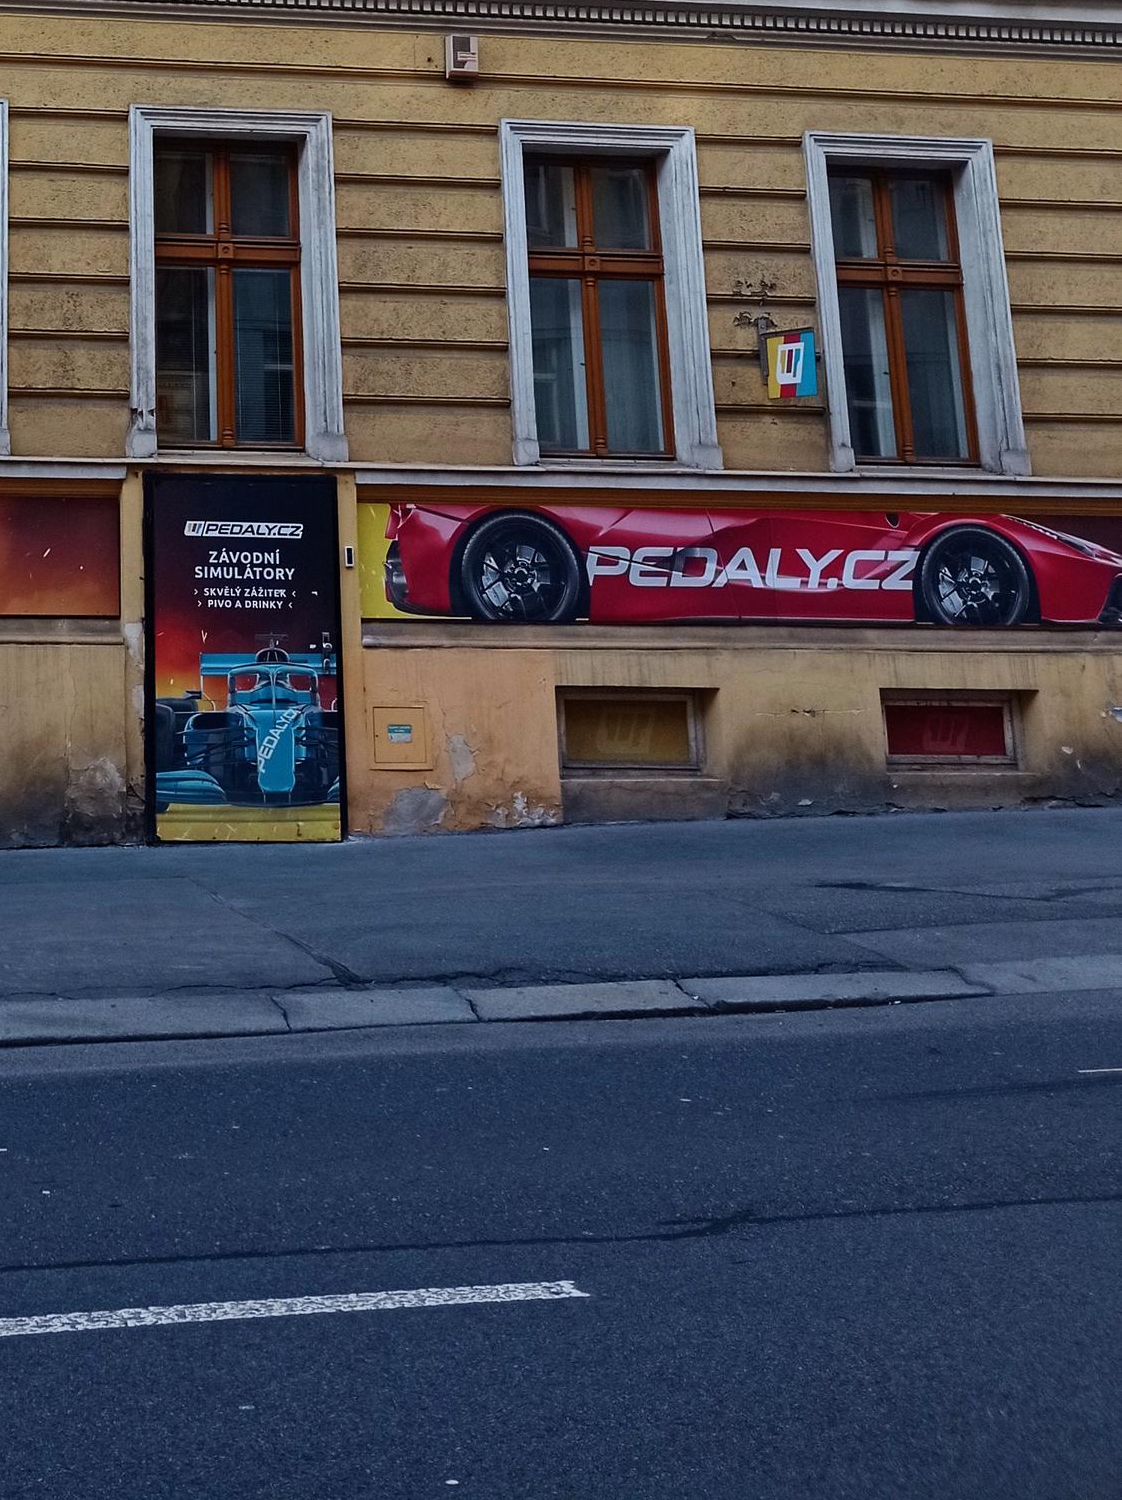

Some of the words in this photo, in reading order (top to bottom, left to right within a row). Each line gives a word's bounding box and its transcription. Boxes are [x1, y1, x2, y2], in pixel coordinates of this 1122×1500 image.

[205, 523, 302, 537] PEDALY.CZ
[208, 547, 280, 565] ZÁVODNÍ
[194, 563, 295, 581] SIMULÁTORY
[585, 546, 921, 591] PEDALY.CZ
[203, 585, 242, 597] SKVĚLÝ
[244, 586, 287, 598] ZÁŽITEK
[207, 599, 232, 609] PIVO
[234, 599, 242, 609] A
[244, 600, 283, 610] DRINKY
